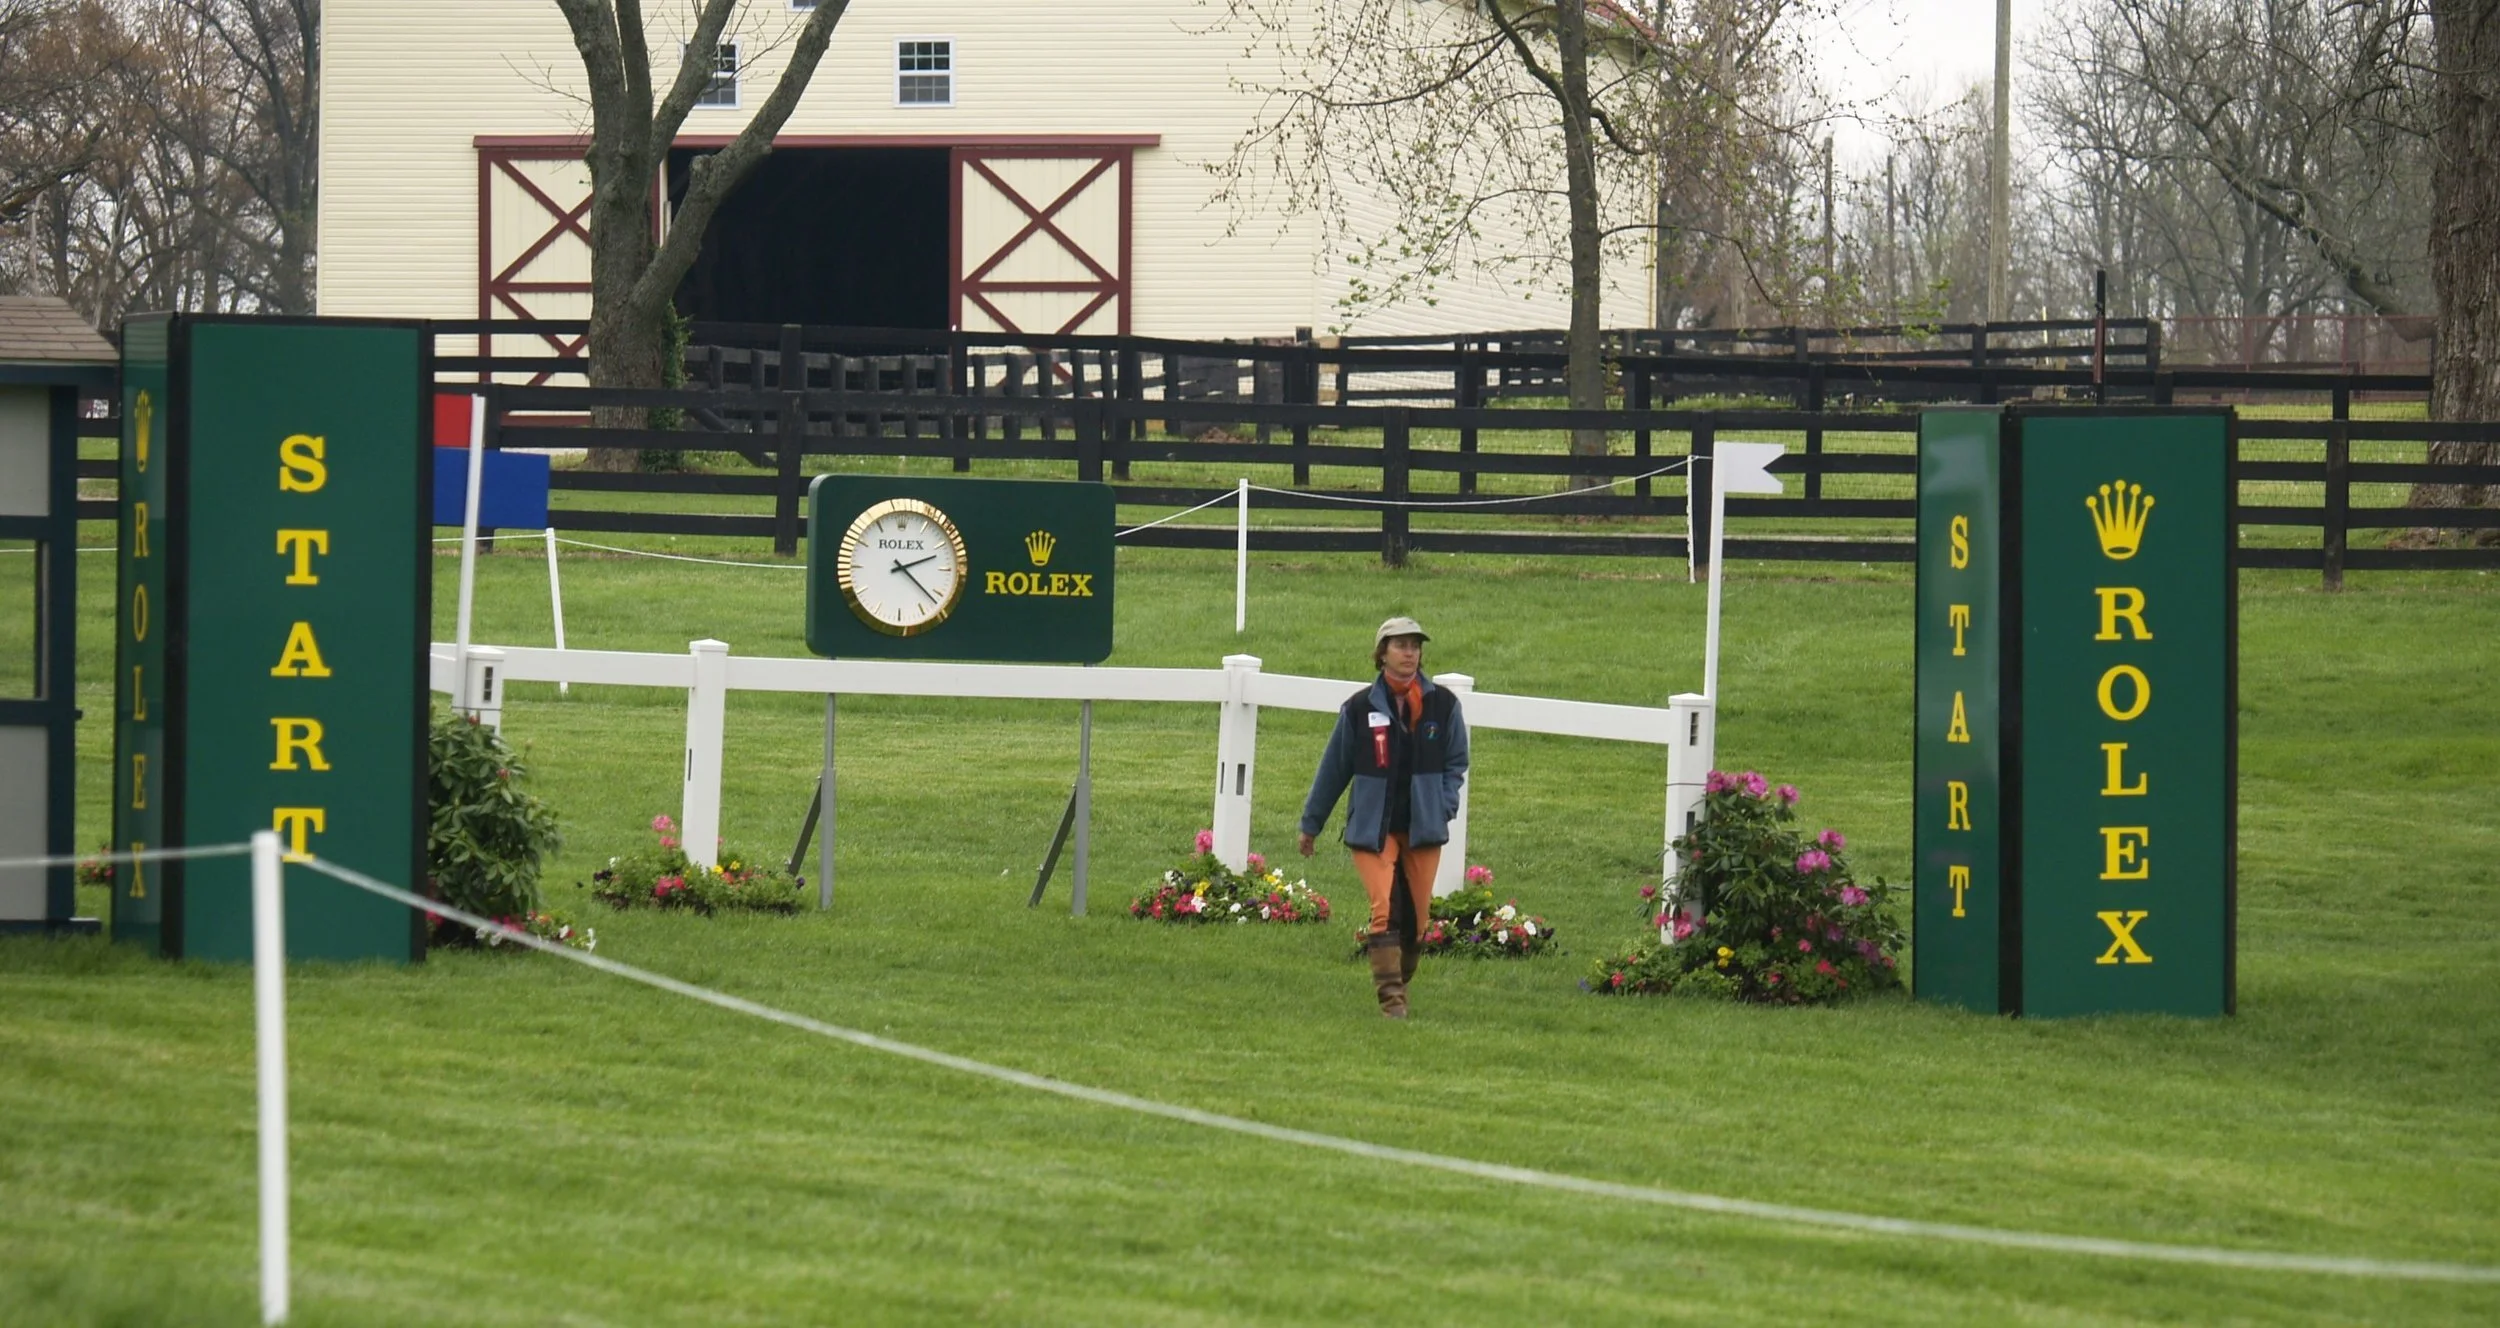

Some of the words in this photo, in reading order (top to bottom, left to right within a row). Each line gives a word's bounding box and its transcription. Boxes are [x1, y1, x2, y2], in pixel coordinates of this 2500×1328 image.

[130, 502, 149, 898] ROLEX
[270, 434, 332, 863] START
[878, 538, 924, 551] ROLEX
[985, 571, 1094, 597] ROLEX
[1947, 515, 1971, 918] START
[2094, 586, 2154, 965] ROLEX
